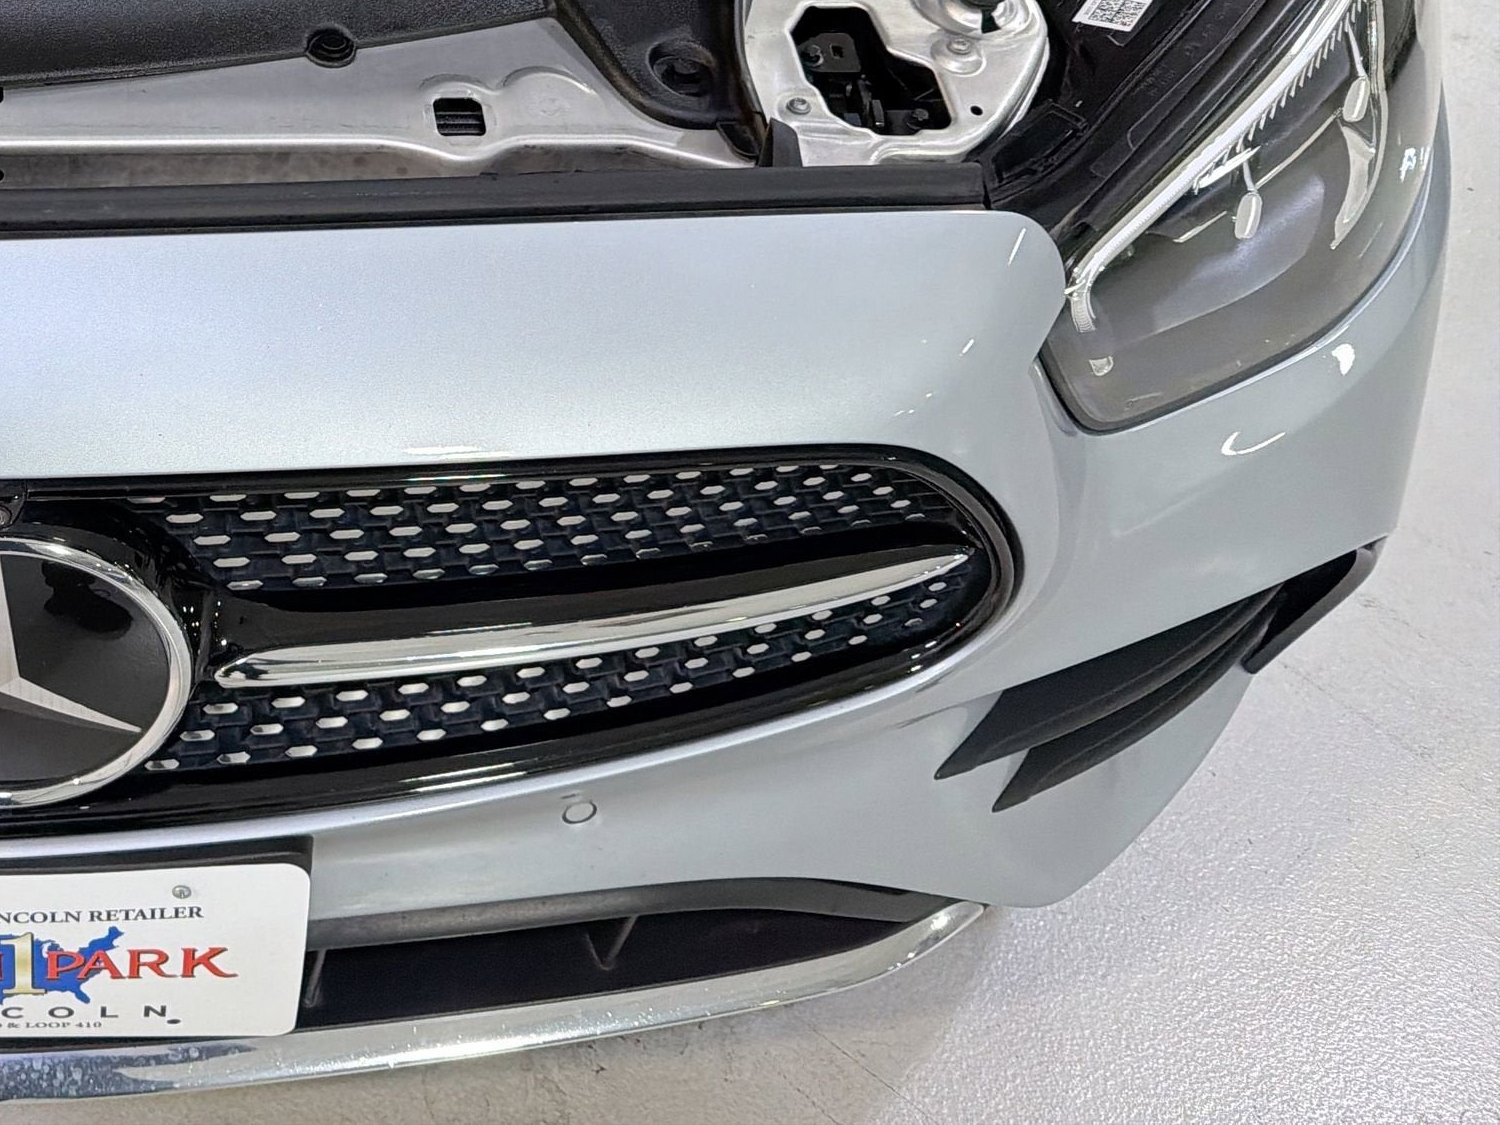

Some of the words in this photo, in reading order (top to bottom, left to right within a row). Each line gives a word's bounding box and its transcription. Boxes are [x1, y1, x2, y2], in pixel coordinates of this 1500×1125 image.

[88, 905, 205, 923] RETAILER
[45, 946, 239, 980] PARK
[7, 1021, 19, 1029] &
[25, 1020, 71, 1029] LOOP
[75, 1020, 103, 1029] 410
